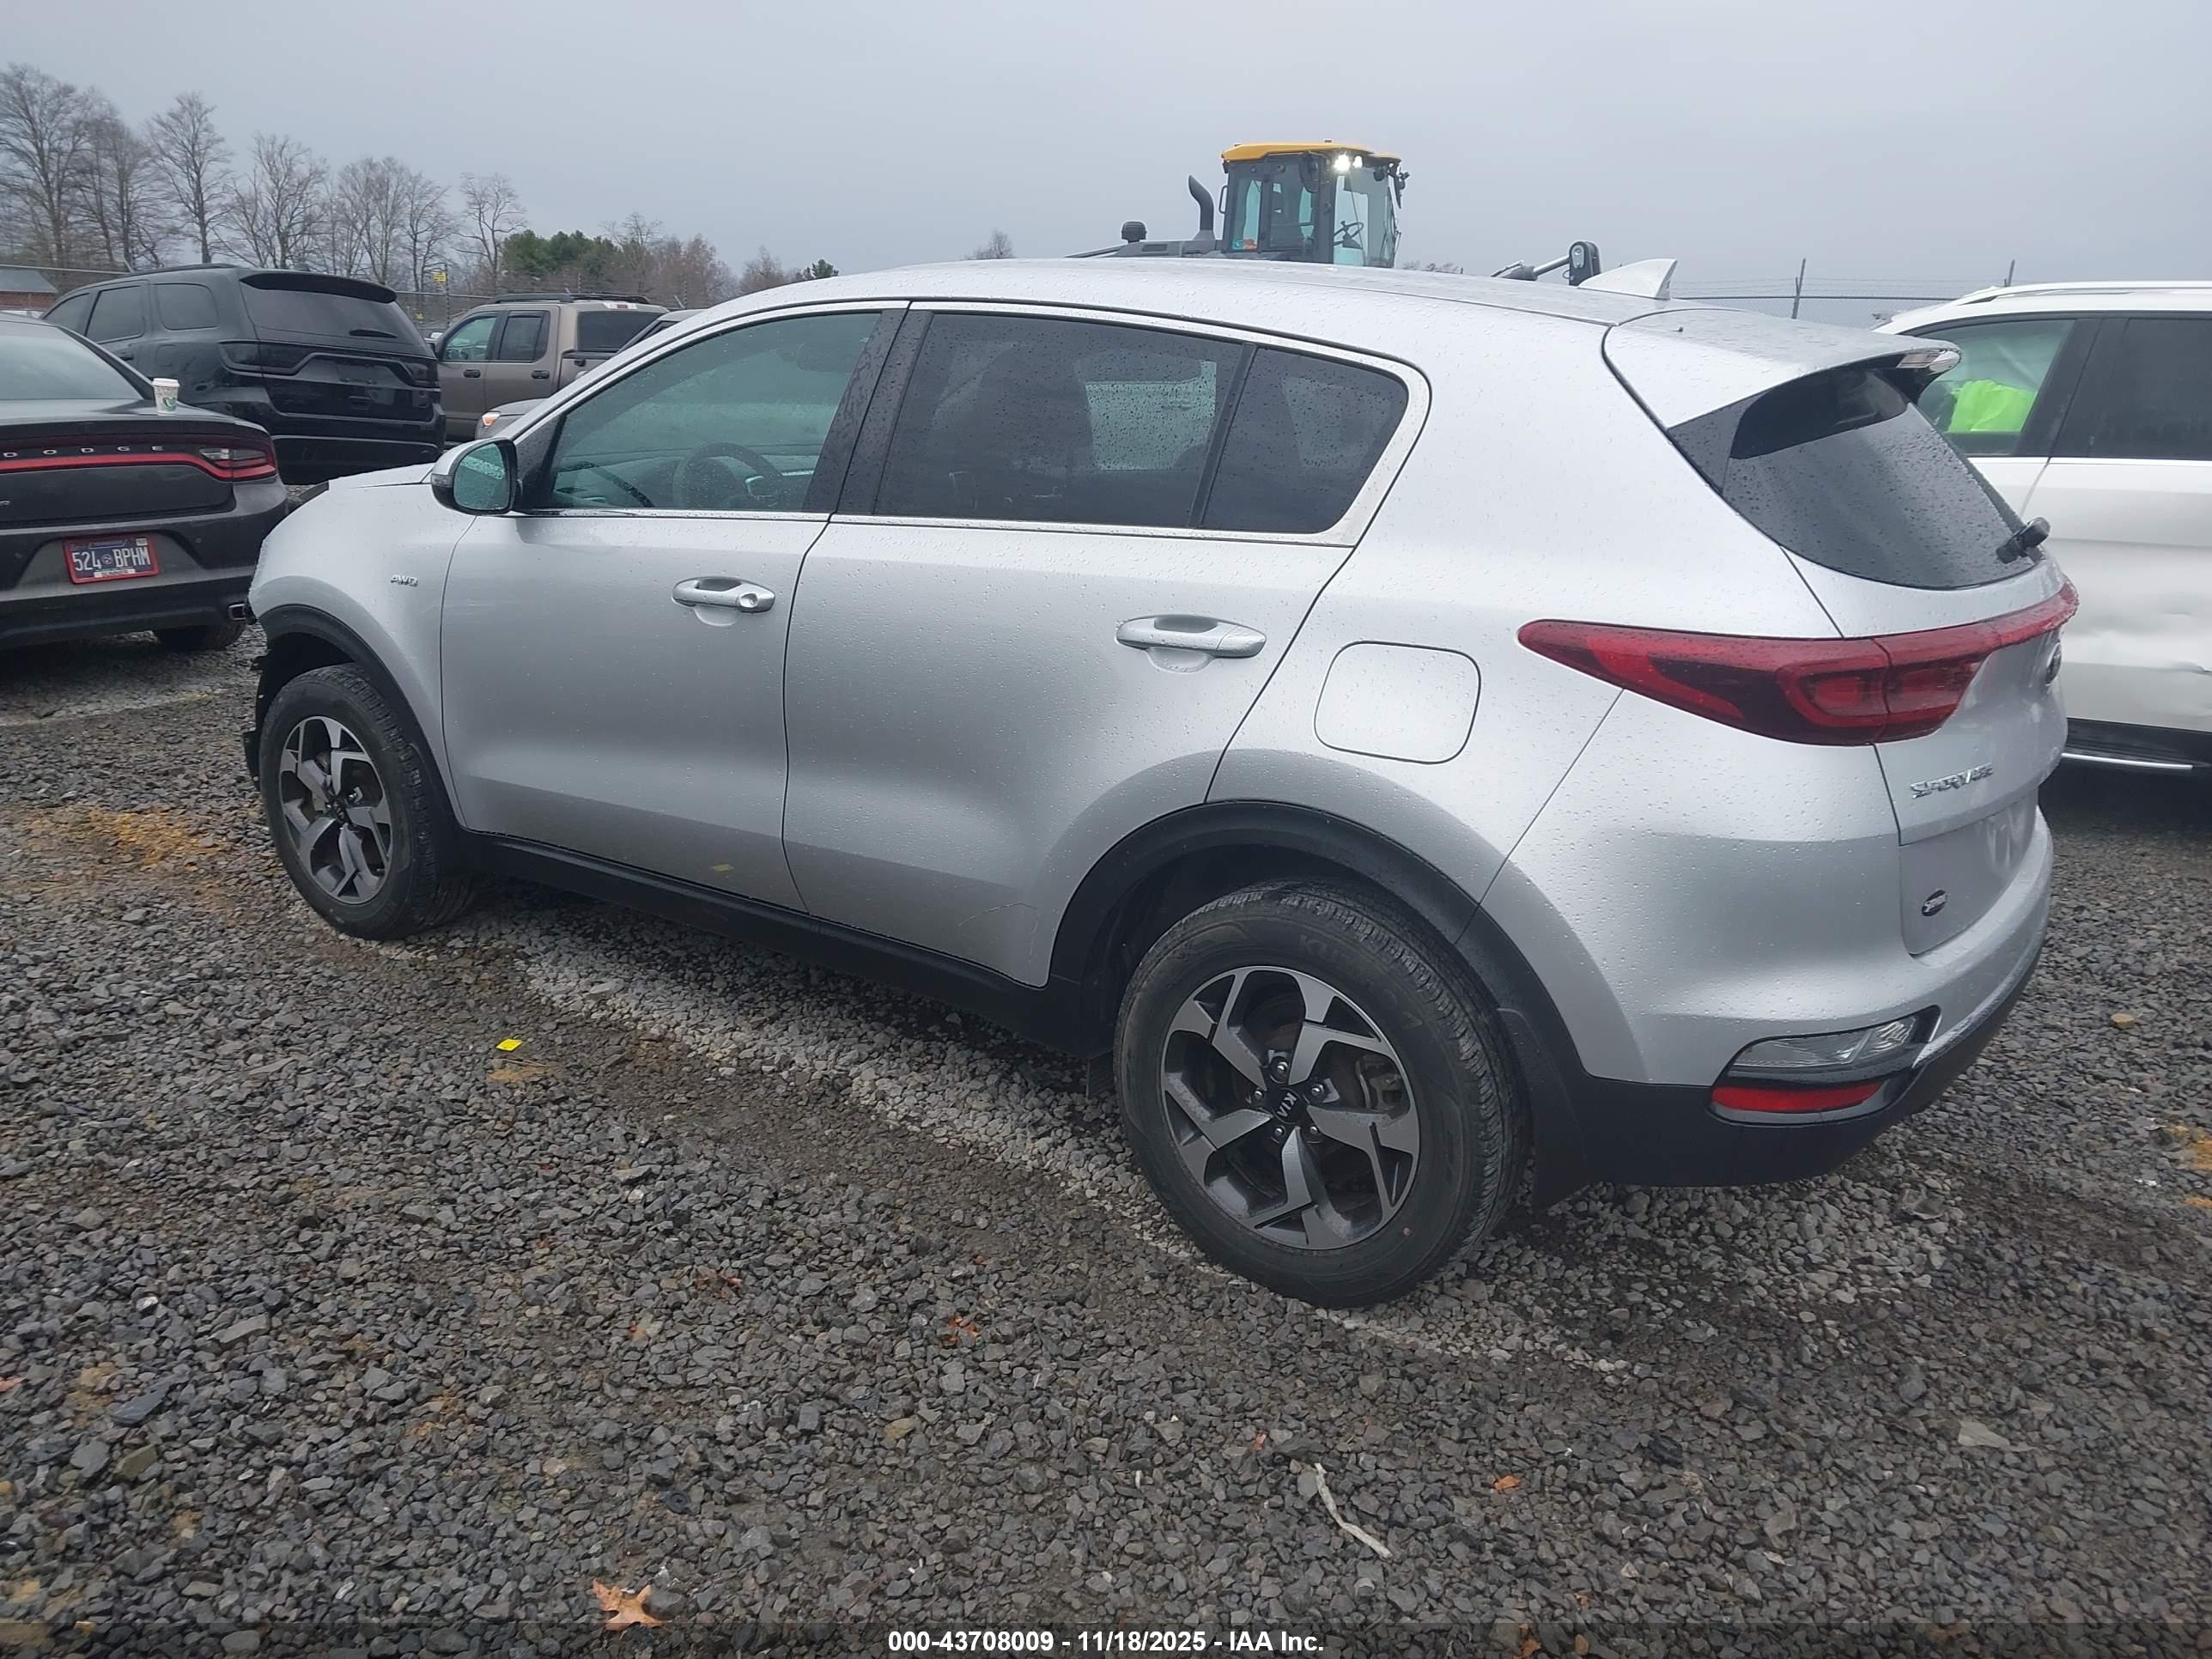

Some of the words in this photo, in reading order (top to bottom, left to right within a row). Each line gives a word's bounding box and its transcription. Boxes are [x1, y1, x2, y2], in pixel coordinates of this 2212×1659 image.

[3, 446, 164, 458] DODGE
[71, 551, 102, 571] 524
[112, 546, 151, 568] BPHM
[391, 574, 418, 586] AWD
[1276, 1091, 1298, 1118] KIA
